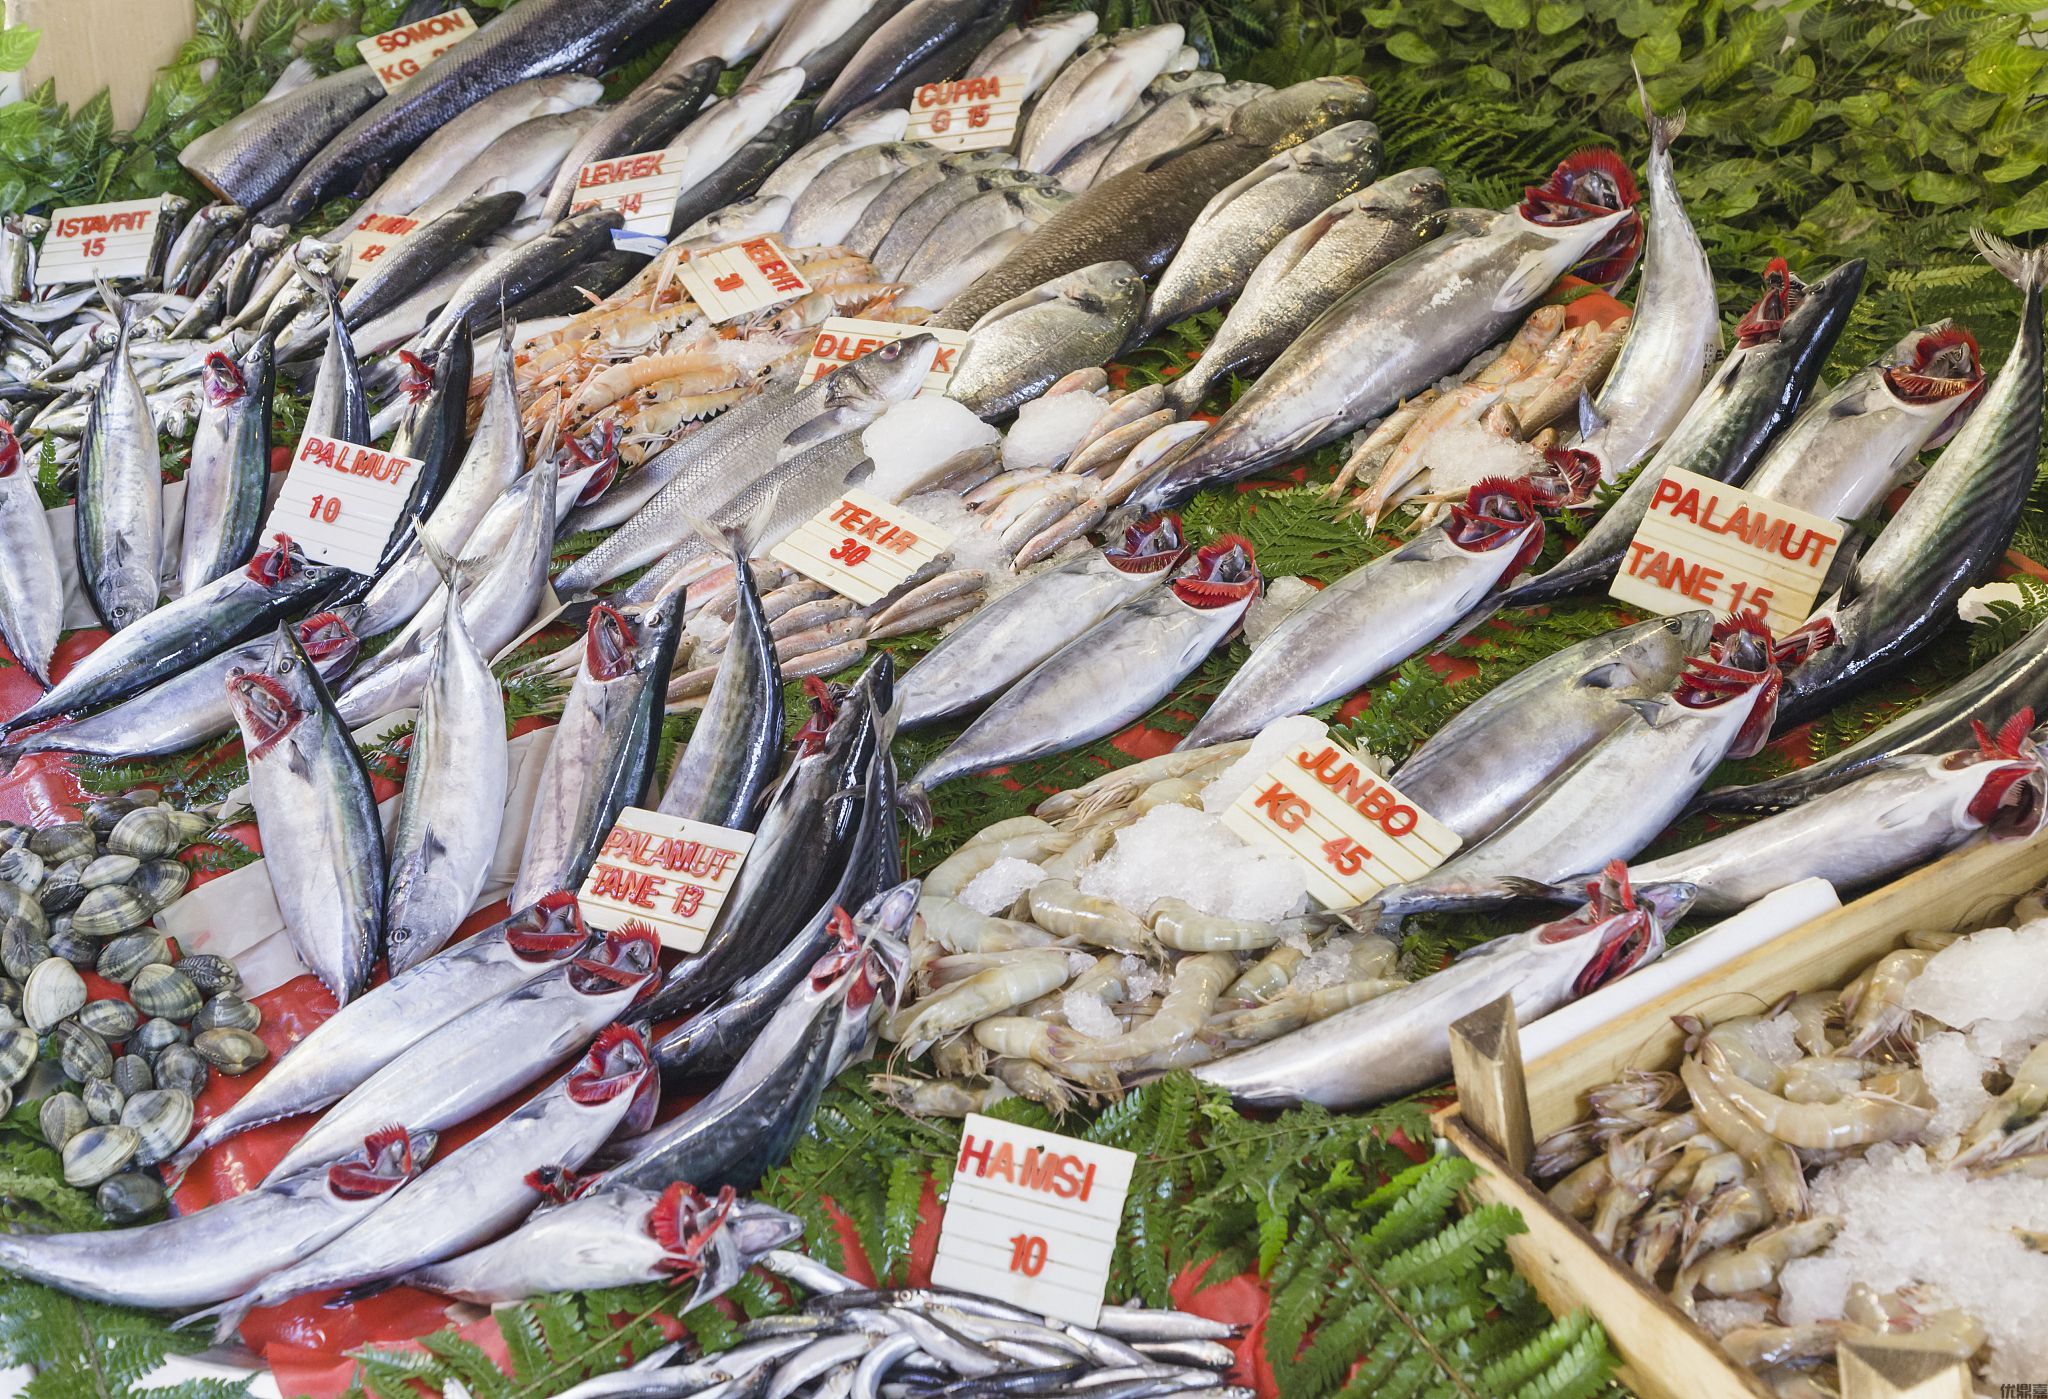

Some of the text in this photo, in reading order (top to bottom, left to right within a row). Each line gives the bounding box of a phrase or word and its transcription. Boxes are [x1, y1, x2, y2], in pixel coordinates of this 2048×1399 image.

[375, 12, 465, 53] SOMON
[379, 58, 421, 84] KG
[918, 75, 1000, 109] CUPRA
[968, 103, 991, 128] 15
[55, 210, 152, 238] ISTAVRIT
[618, 192, 642, 216] 14
[82, 237, 106, 257] 15
[300, 437, 411, 485] PALMUT
[309, 494, 342, 523] 10
[829, 500, 919, 554] TEKIR
[1650, 478, 1837, 567] PALAMUT
[829, 537, 871, 567] 30
[1629, 541, 1774, 620] TANE 15
[1297, 746, 1418, 837] JUNBO
[1254, 781, 1373, 876] KG 45
[600, 826, 736, 881] PALAMUT
[590, 863, 705, 917] TANE 13
[957, 1135, 1097, 1203] HAMSI
[1009, 1233, 1048, 1278] 10
